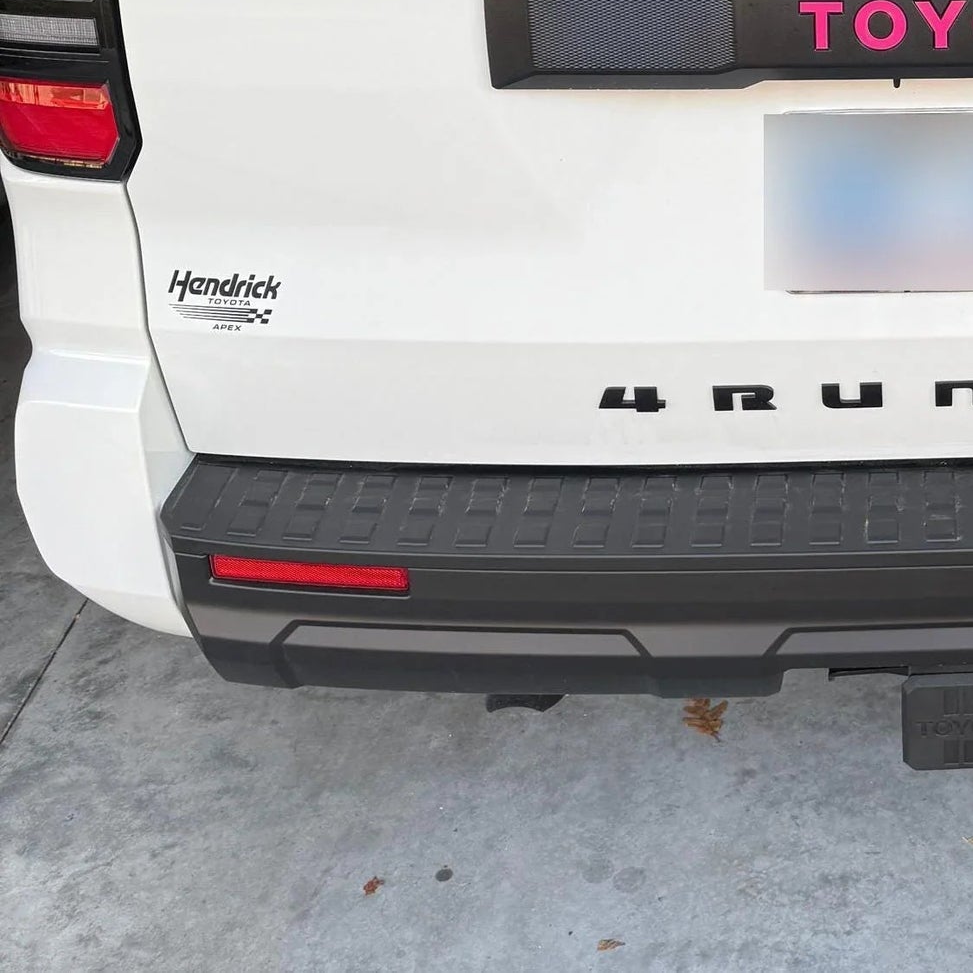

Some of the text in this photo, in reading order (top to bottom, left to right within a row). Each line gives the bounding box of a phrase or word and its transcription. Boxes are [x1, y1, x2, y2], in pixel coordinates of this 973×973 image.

[168, 269, 282, 302] Hendrick
[208, 298, 251, 306] TOYOTA
[212, 323, 242, 331] APEX
